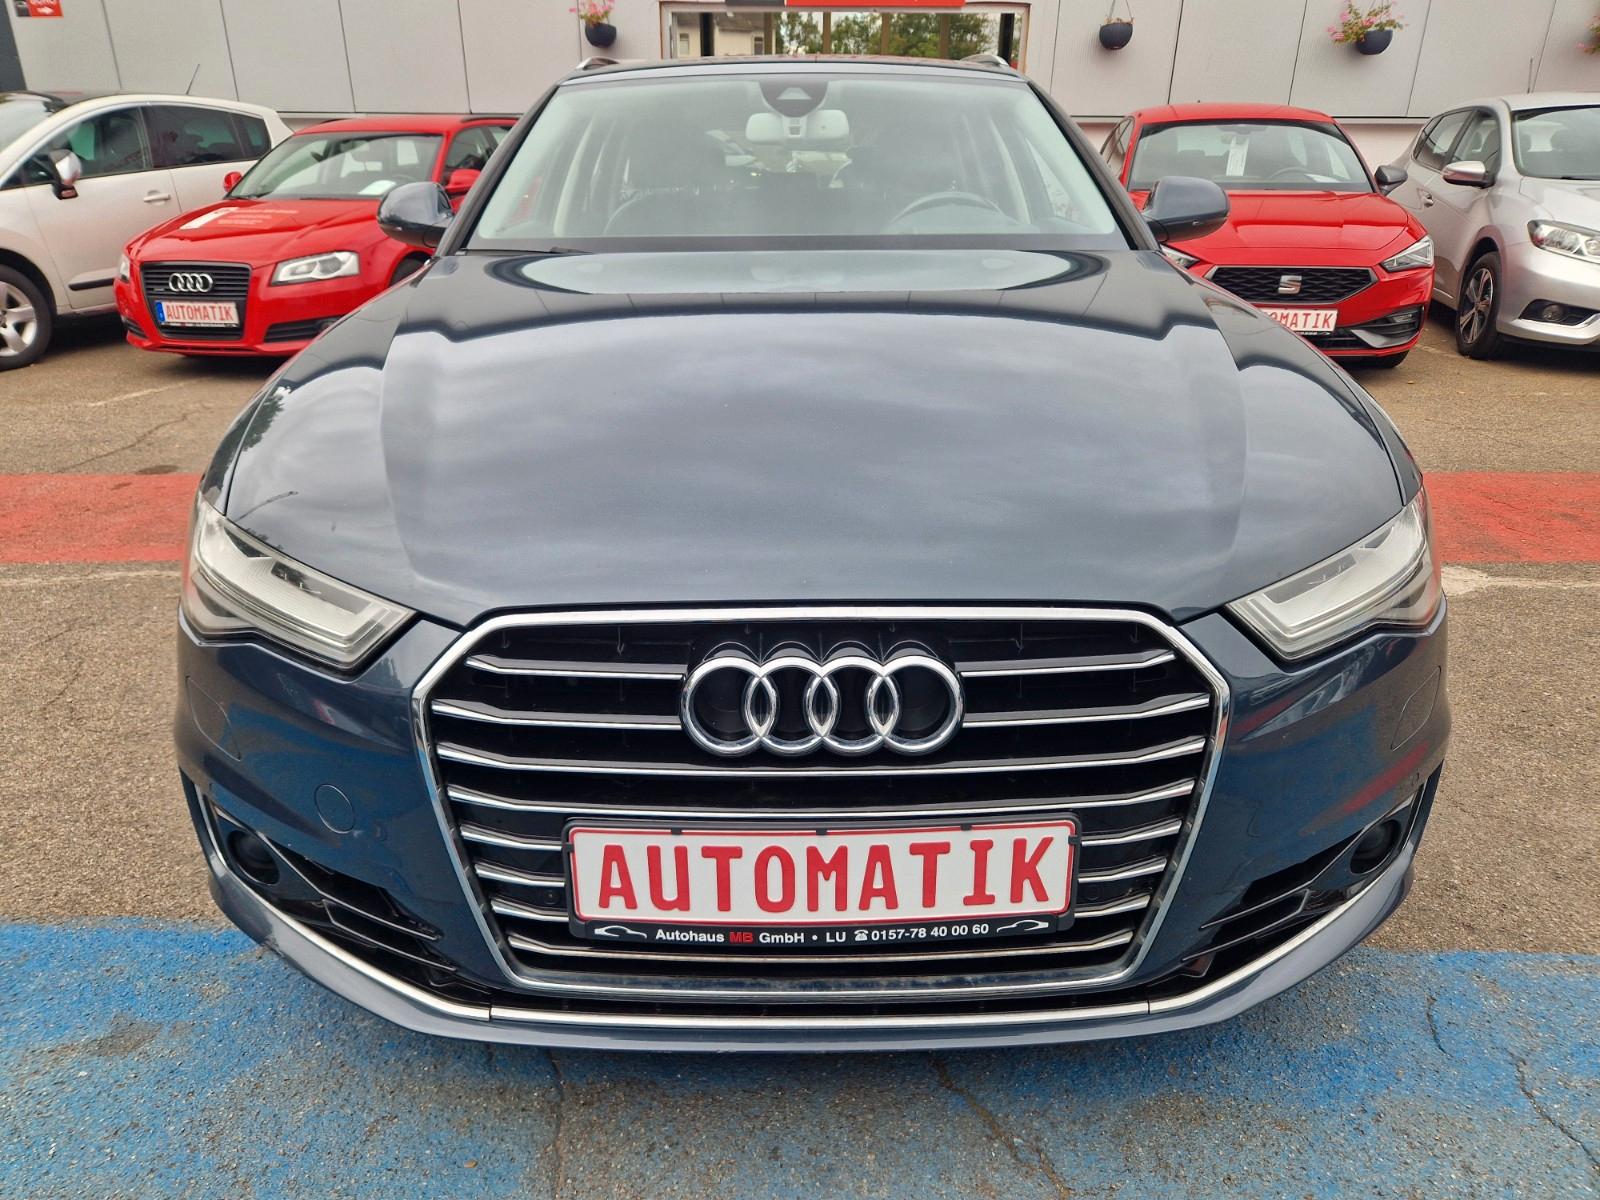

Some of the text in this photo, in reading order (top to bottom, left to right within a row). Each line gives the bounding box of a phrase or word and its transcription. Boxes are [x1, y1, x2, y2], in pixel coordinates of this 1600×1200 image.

[166, 304, 234, 321] AUTOMATIK
[598, 837, 1054, 913] AUTOMATIK
[656, 924, 989, 944] Autohaus MB GmbH LU 0157-78 40 00 60
